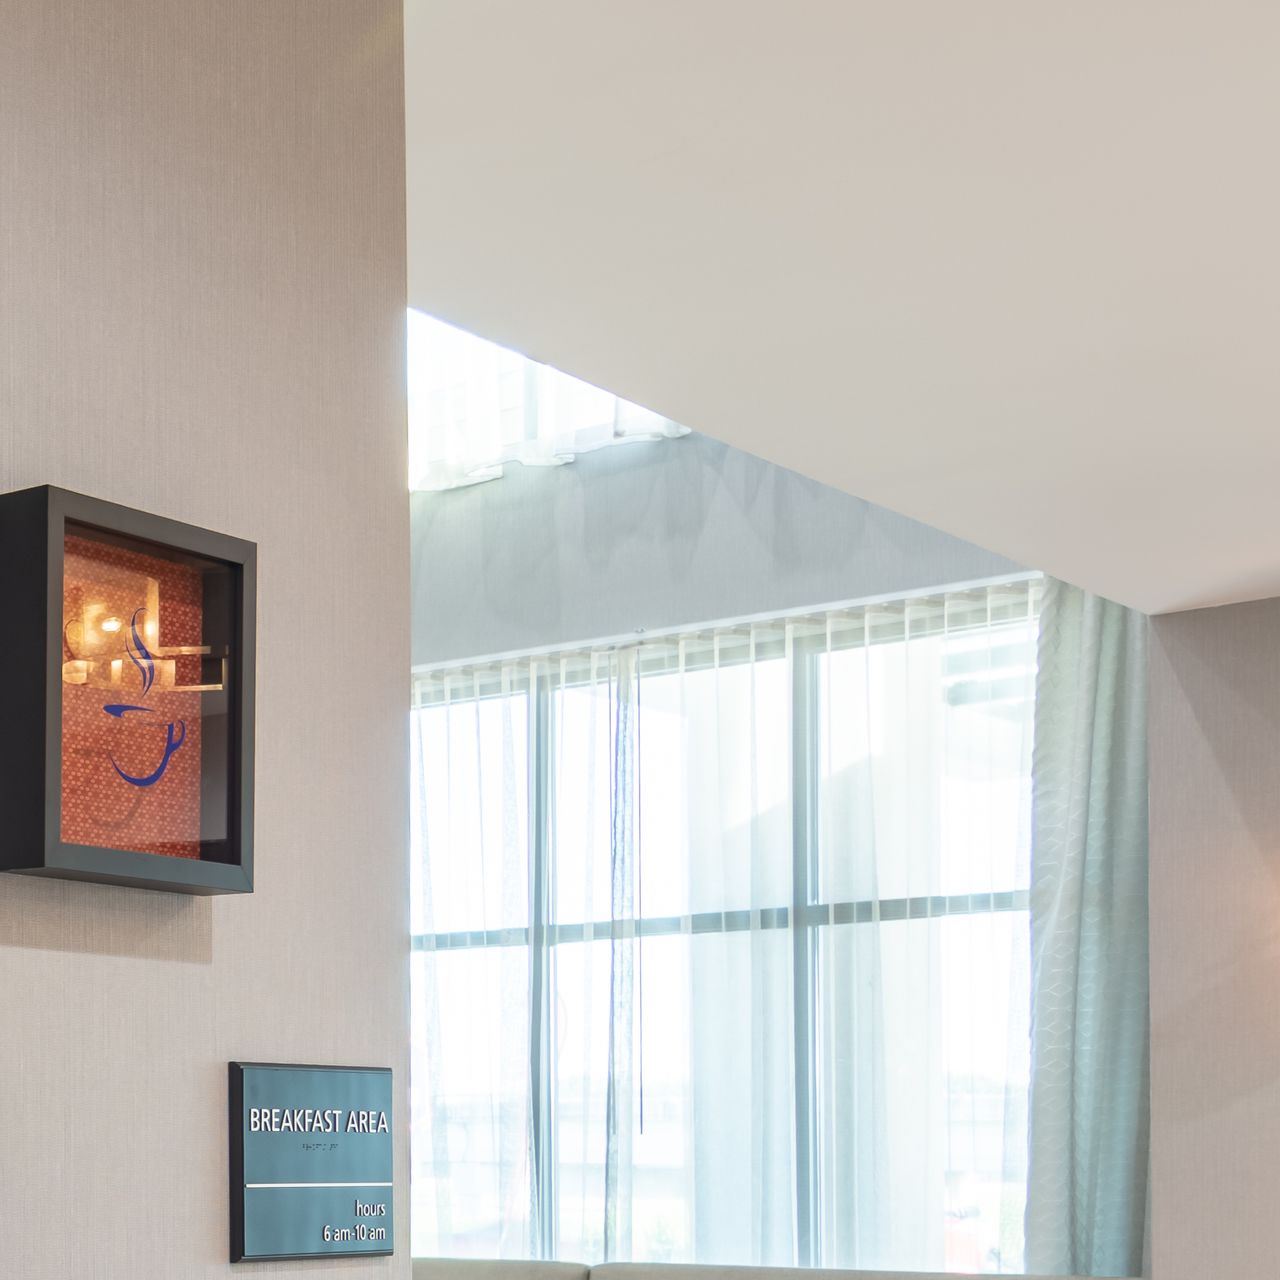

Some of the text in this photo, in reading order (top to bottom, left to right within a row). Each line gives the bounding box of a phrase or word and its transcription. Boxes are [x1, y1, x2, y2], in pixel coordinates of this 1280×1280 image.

[249, 1108, 390, 1134] BREAKFAST AREA
[355, 1199, 386, 1217] hours
[323, 1224, 331, 1242] 6
[368, 1227, 386, 1241] am
